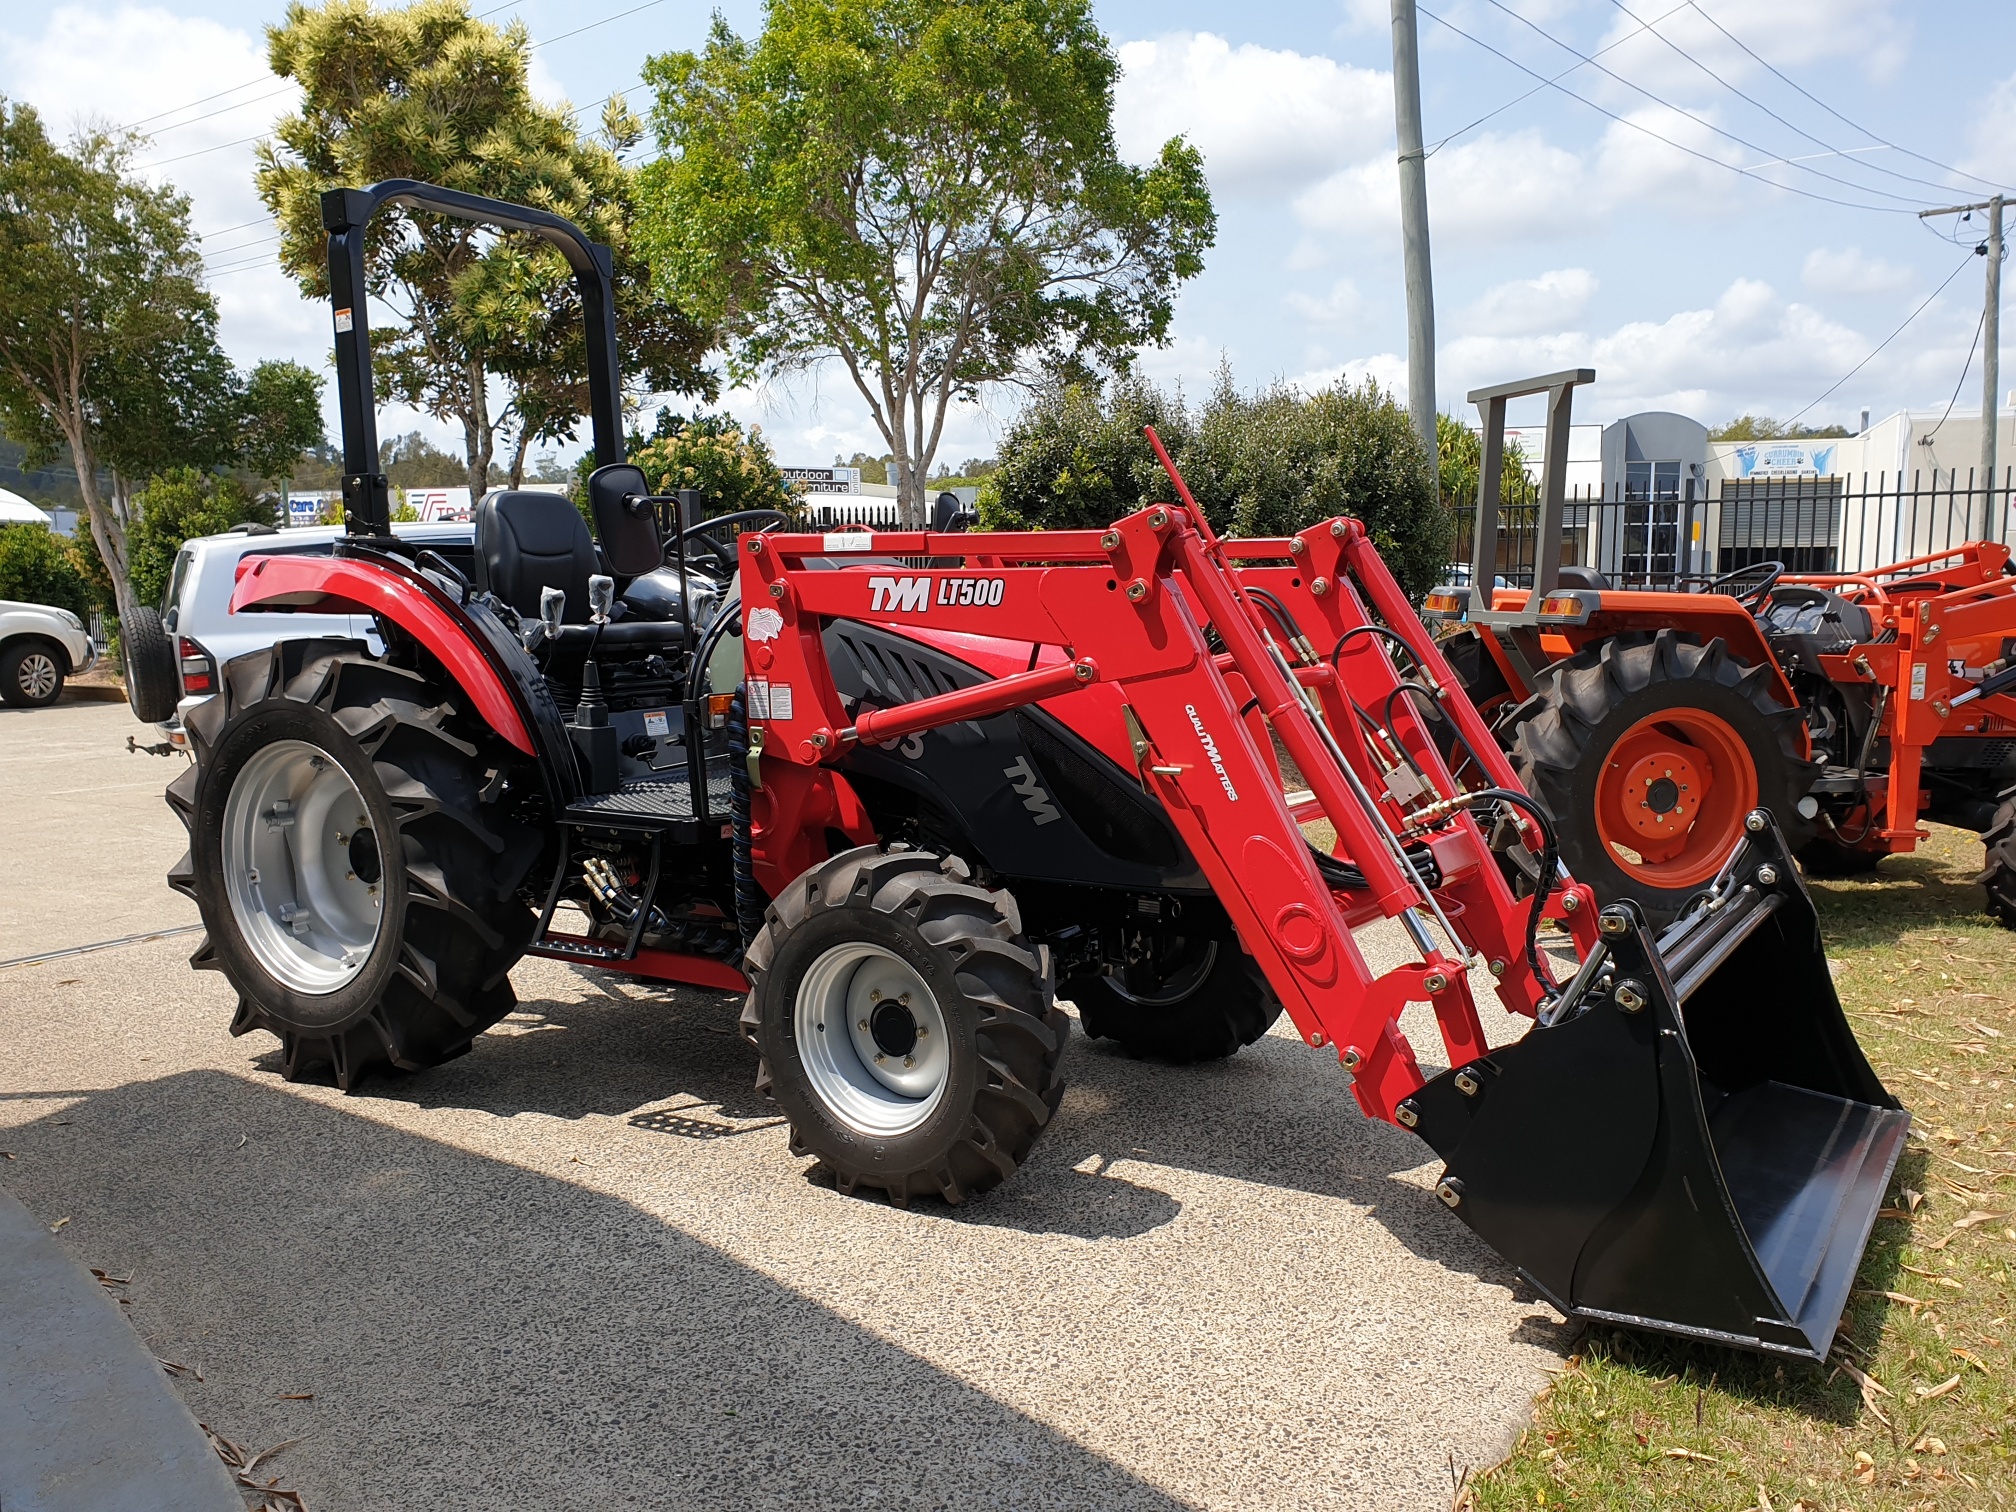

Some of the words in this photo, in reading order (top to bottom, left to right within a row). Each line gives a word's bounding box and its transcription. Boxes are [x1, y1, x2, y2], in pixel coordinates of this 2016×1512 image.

[868, 577, 932, 612] TYM
[936, 578, 1005, 606] LT500
[1003, 755, 1061, 826] TYM
